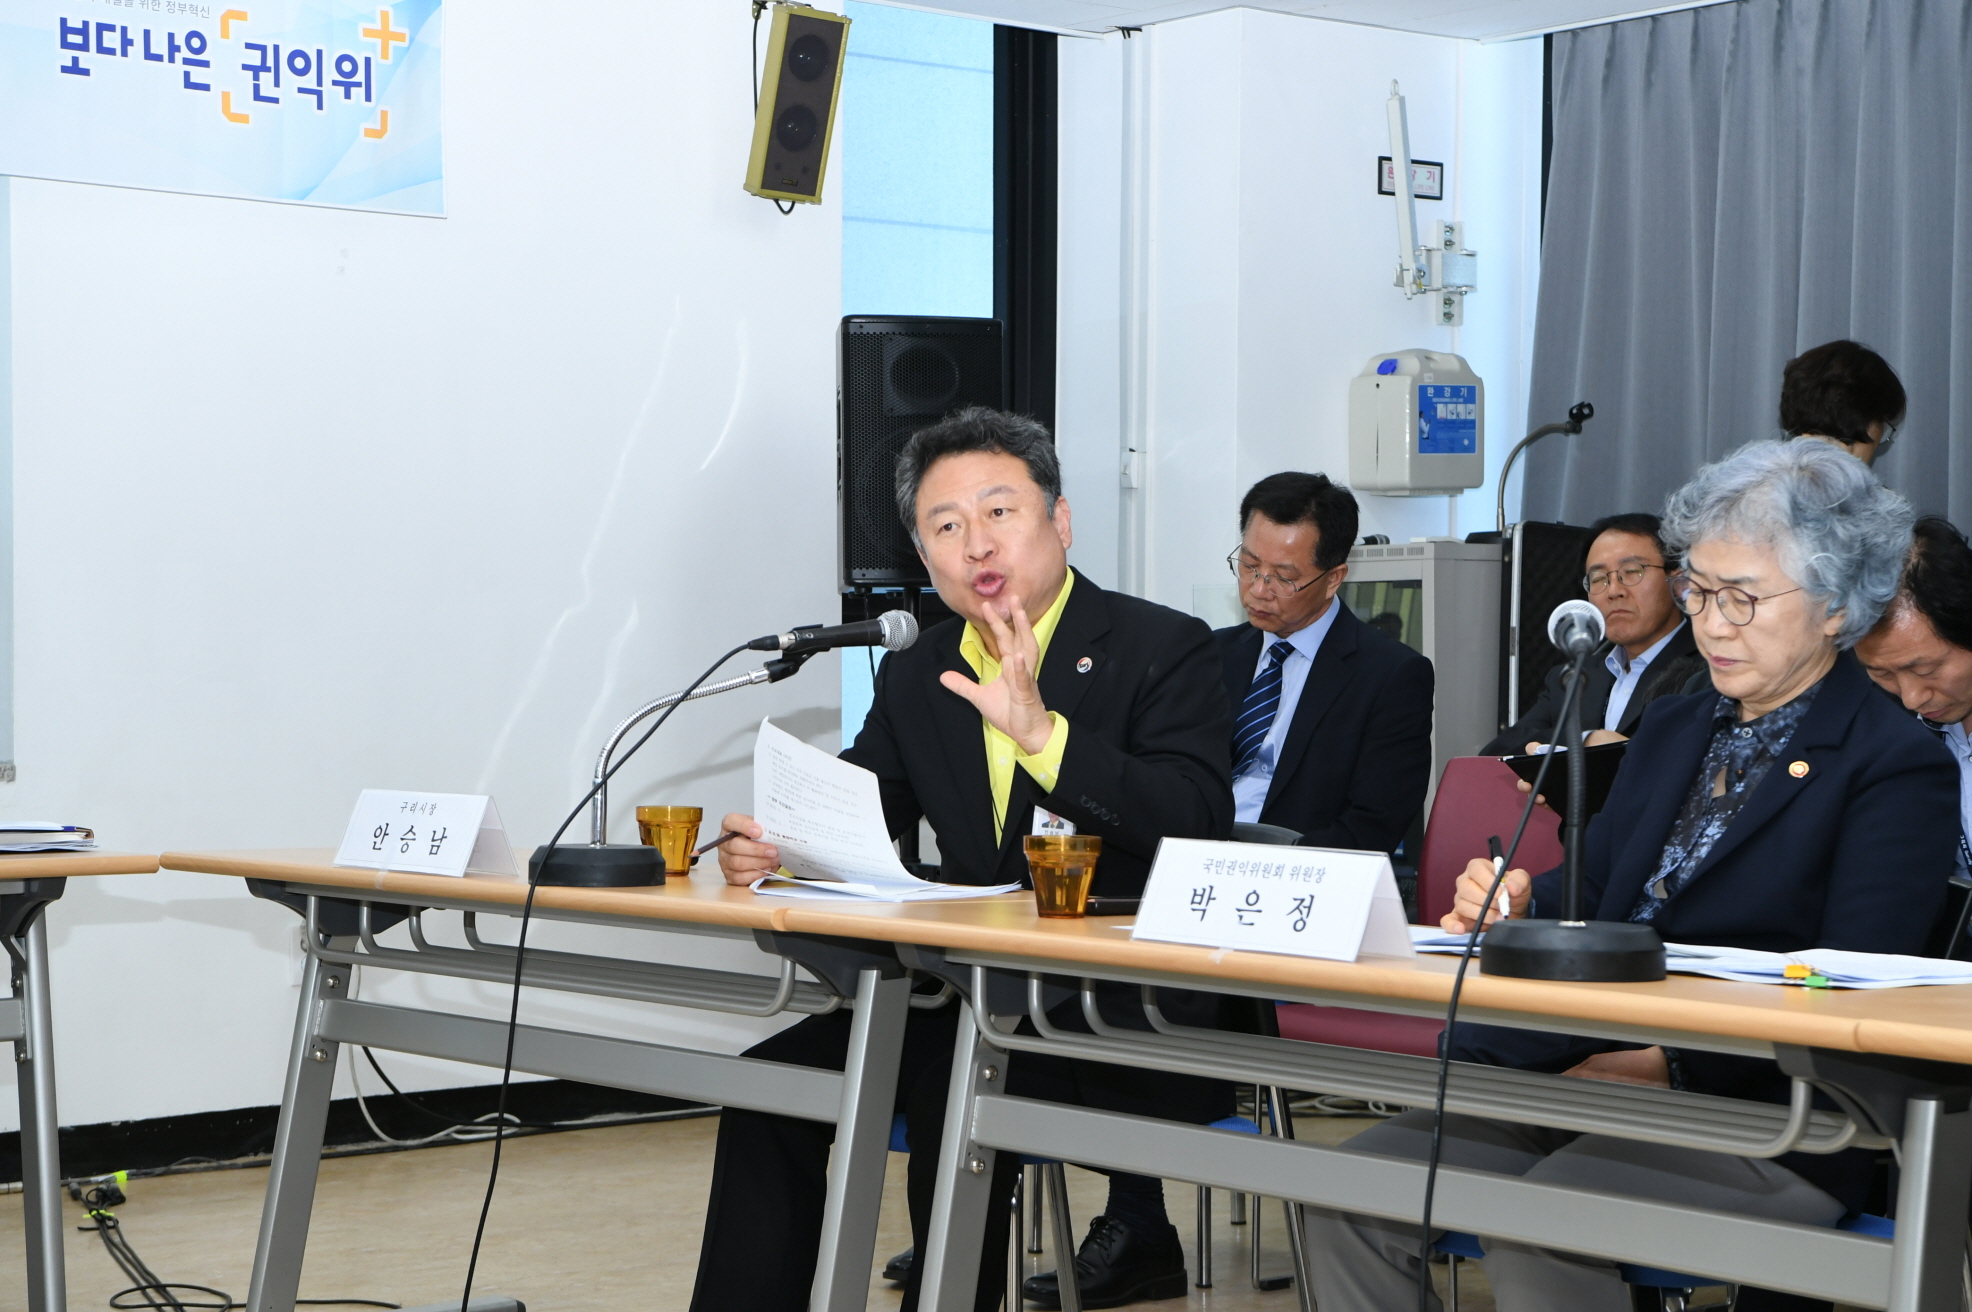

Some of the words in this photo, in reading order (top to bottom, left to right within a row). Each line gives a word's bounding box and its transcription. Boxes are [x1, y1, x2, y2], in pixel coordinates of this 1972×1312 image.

[139, 0, 161, 12] 위한
[165, 0, 210, 19] 정부혁신
[59, 16, 134, 77] 보다
[143, 28, 211, 92] 나은
[241, 41, 372, 111] 권익위
[400, 801, 437, 816] 구리시장
[1203, 858, 1286, 879] 국민권익위원회
[1289, 865, 1327, 884] 위원장
